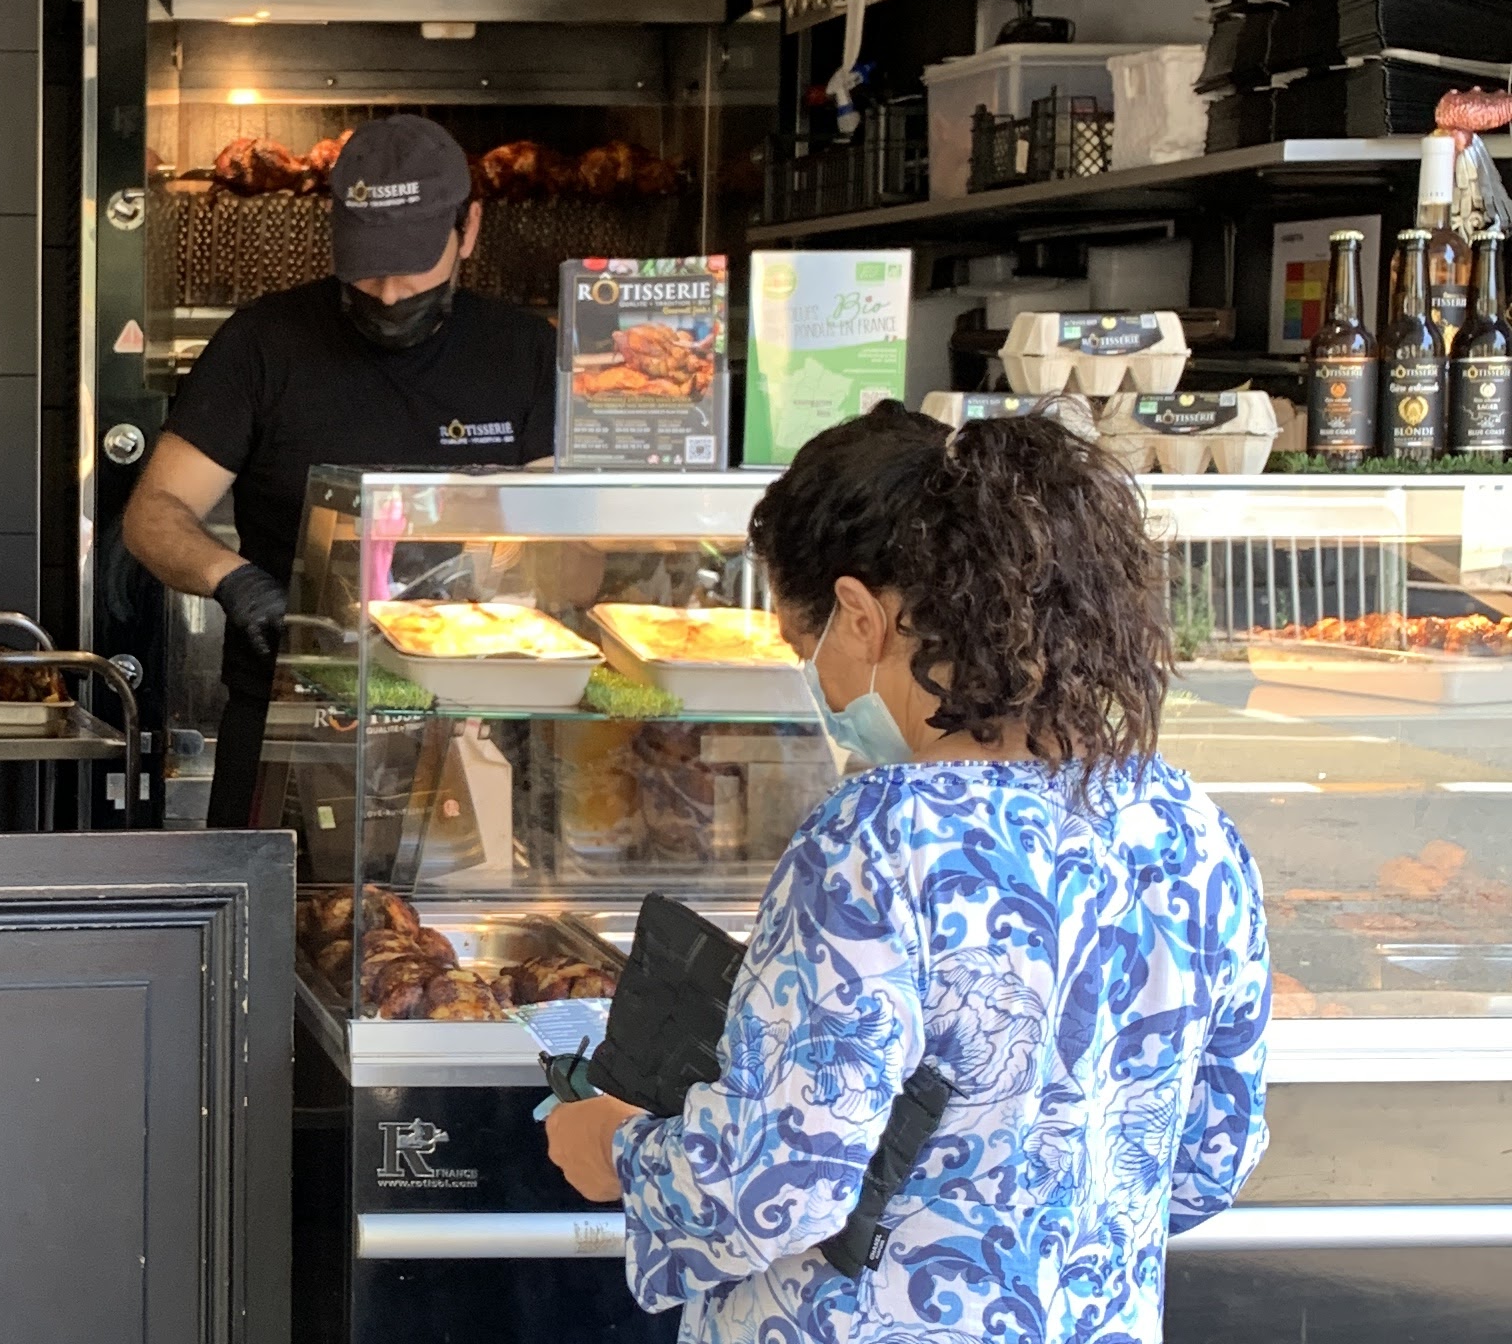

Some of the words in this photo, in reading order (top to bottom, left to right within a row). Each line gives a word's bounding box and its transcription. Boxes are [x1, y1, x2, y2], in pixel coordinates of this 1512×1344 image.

[578, 272, 711, 305] RÔTISSERIE
[858, 316, 896, 334] FRANCE
[436, 1168, 479, 1179] FRANCE
